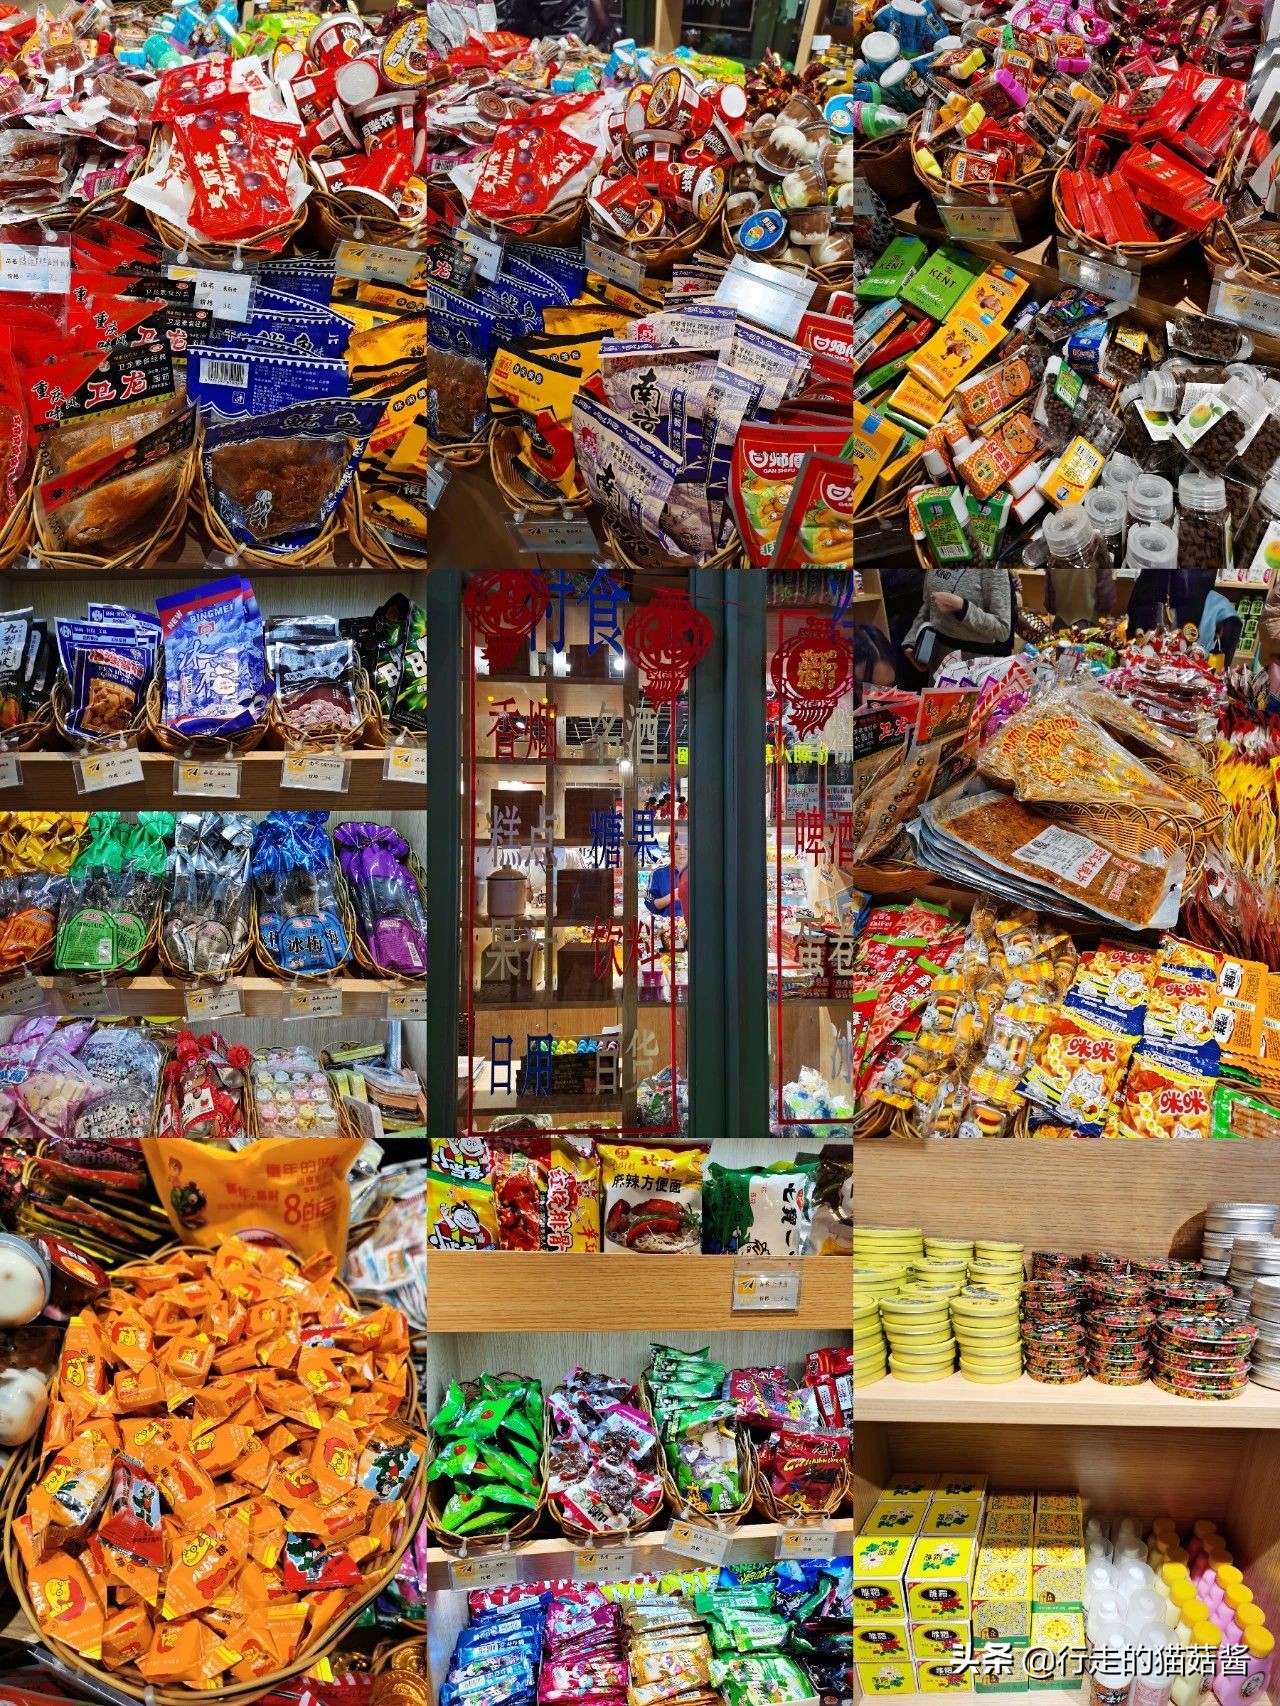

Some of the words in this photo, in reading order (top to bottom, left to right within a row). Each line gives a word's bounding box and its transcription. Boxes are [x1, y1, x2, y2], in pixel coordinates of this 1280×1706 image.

[497, 147, 516, 189] Mylikes
[878, 260, 905, 271] KENT
[928, 267, 957, 289] KENT
[84, 369, 149, 409] 卫龙
[167, 609, 183, 631] NEW
[188, 603, 235, 624] BINGMEI
[486, 696, 559, 761] 香烟
[588, 700, 661, 766] 名酒
[589, 807, 659, 869] 糖果
[794, 809, 854, 868] 啤酒
[287, 936, 324, 953] 冰梅
[591, 915, 660, 980] 饮料
[1110, 951, 1153, 965] 咪咪
[1164, 982, 1207, 998] 咪咪
[1067, 1036, 1117, 1063] 咪咪
[490, 1032, 554, 1097] 日用
[1159, 1089, 1209, 1116] 咪咪
[640, 1153, 677, 1174] 北京
[611, 1173, 683, 1194] 麻辣方便面
[547, 1167, 571, 1252] 红烧排骨
